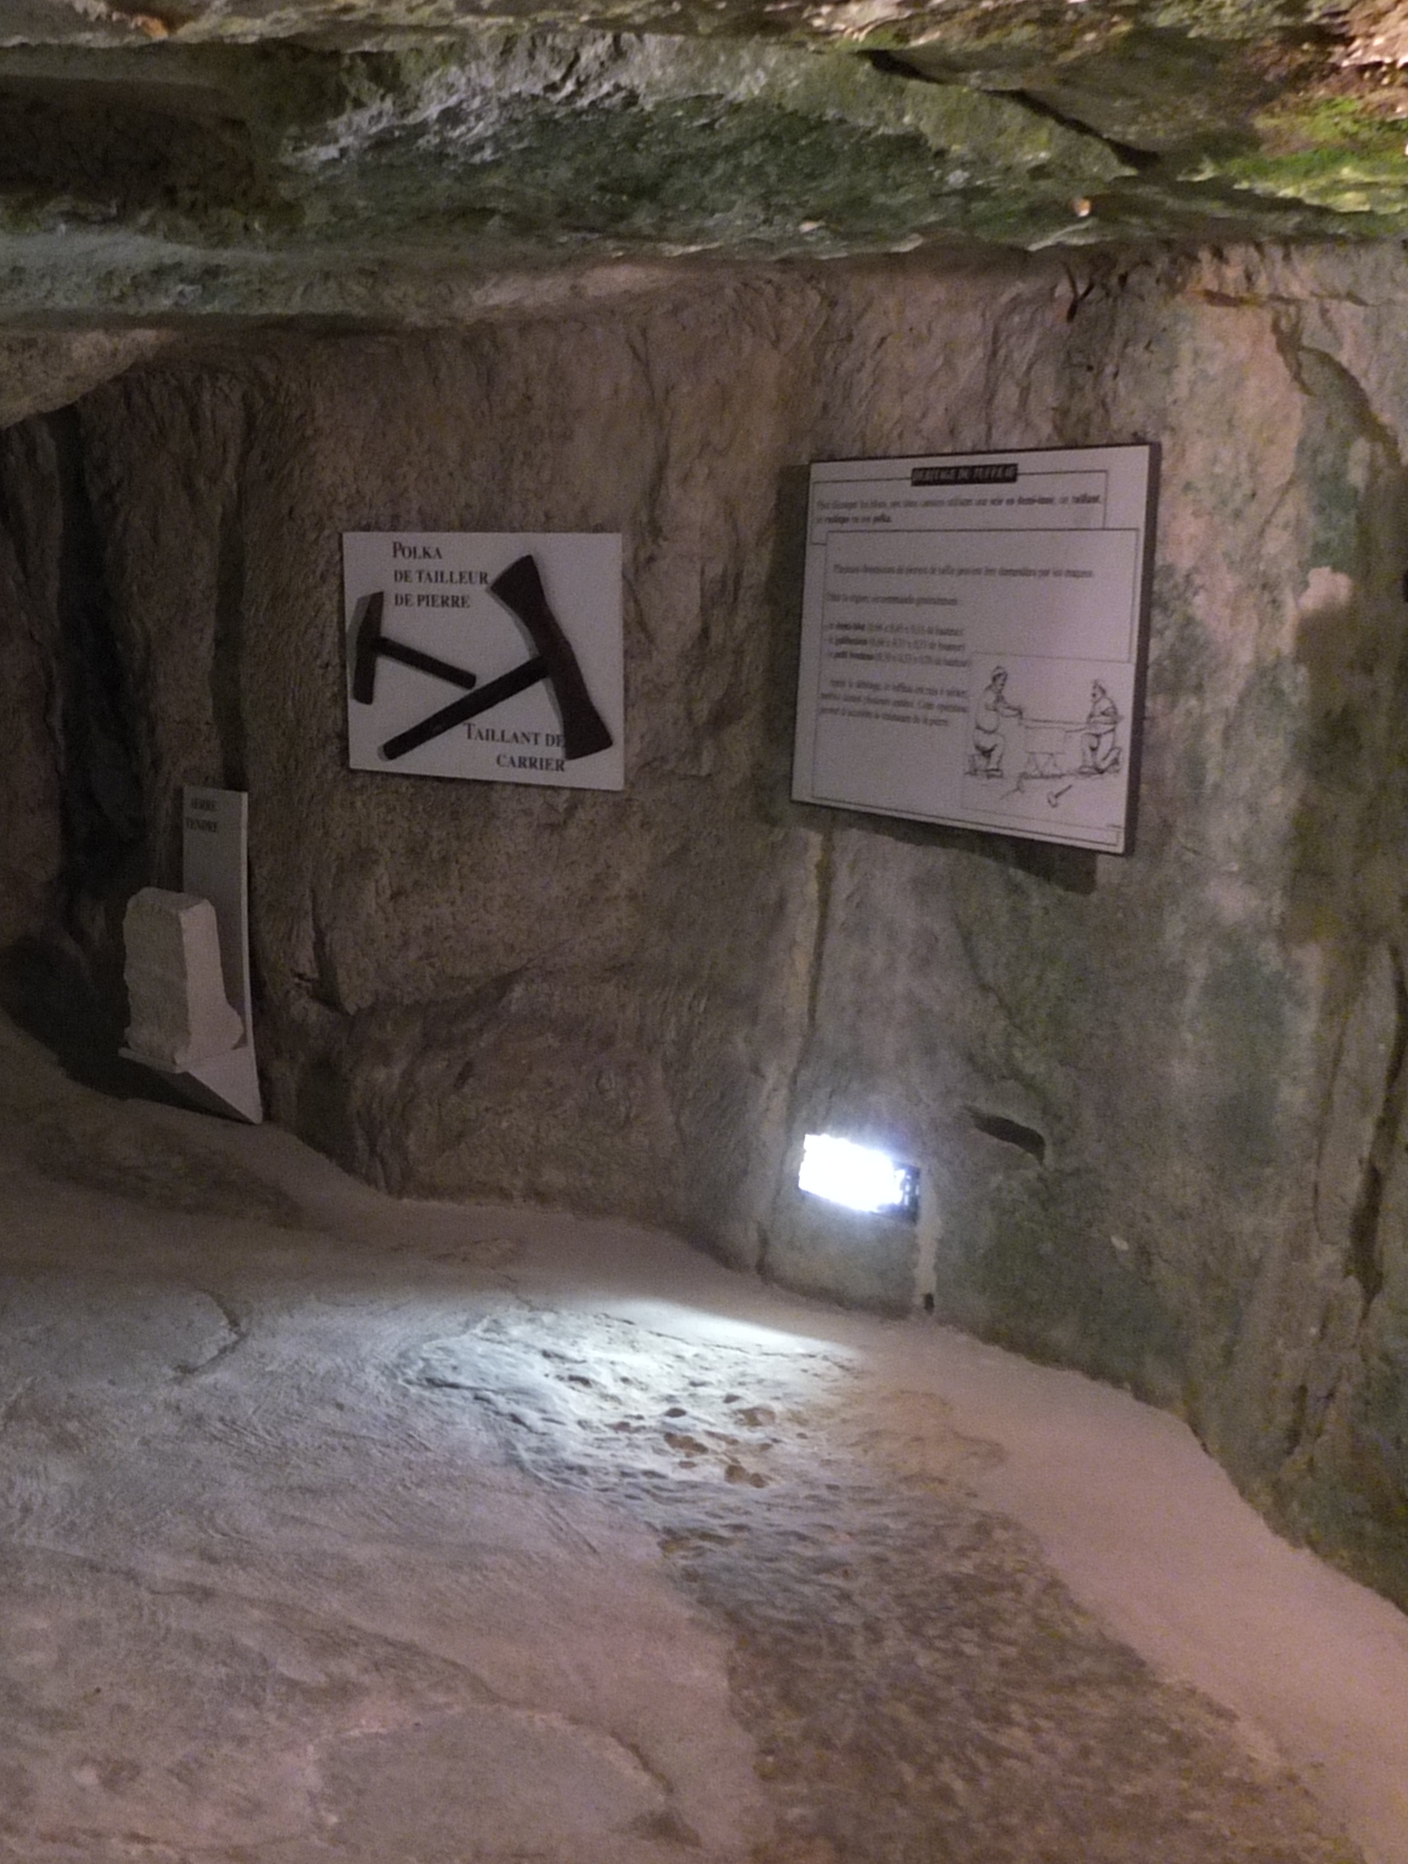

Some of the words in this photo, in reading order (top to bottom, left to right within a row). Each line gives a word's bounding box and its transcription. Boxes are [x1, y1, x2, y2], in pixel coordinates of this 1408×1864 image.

[393, 542, 442, 559] POLKA
[394, 570, 412, 583] DE
[416, 570, 489, 585] TAILLEUR
[394, 595, 412, 607] DE
[417, 595, 471, 609] PIERRE
[545, 733, 565, 747] DE
[496, 754, 566, 773] CARRIER
